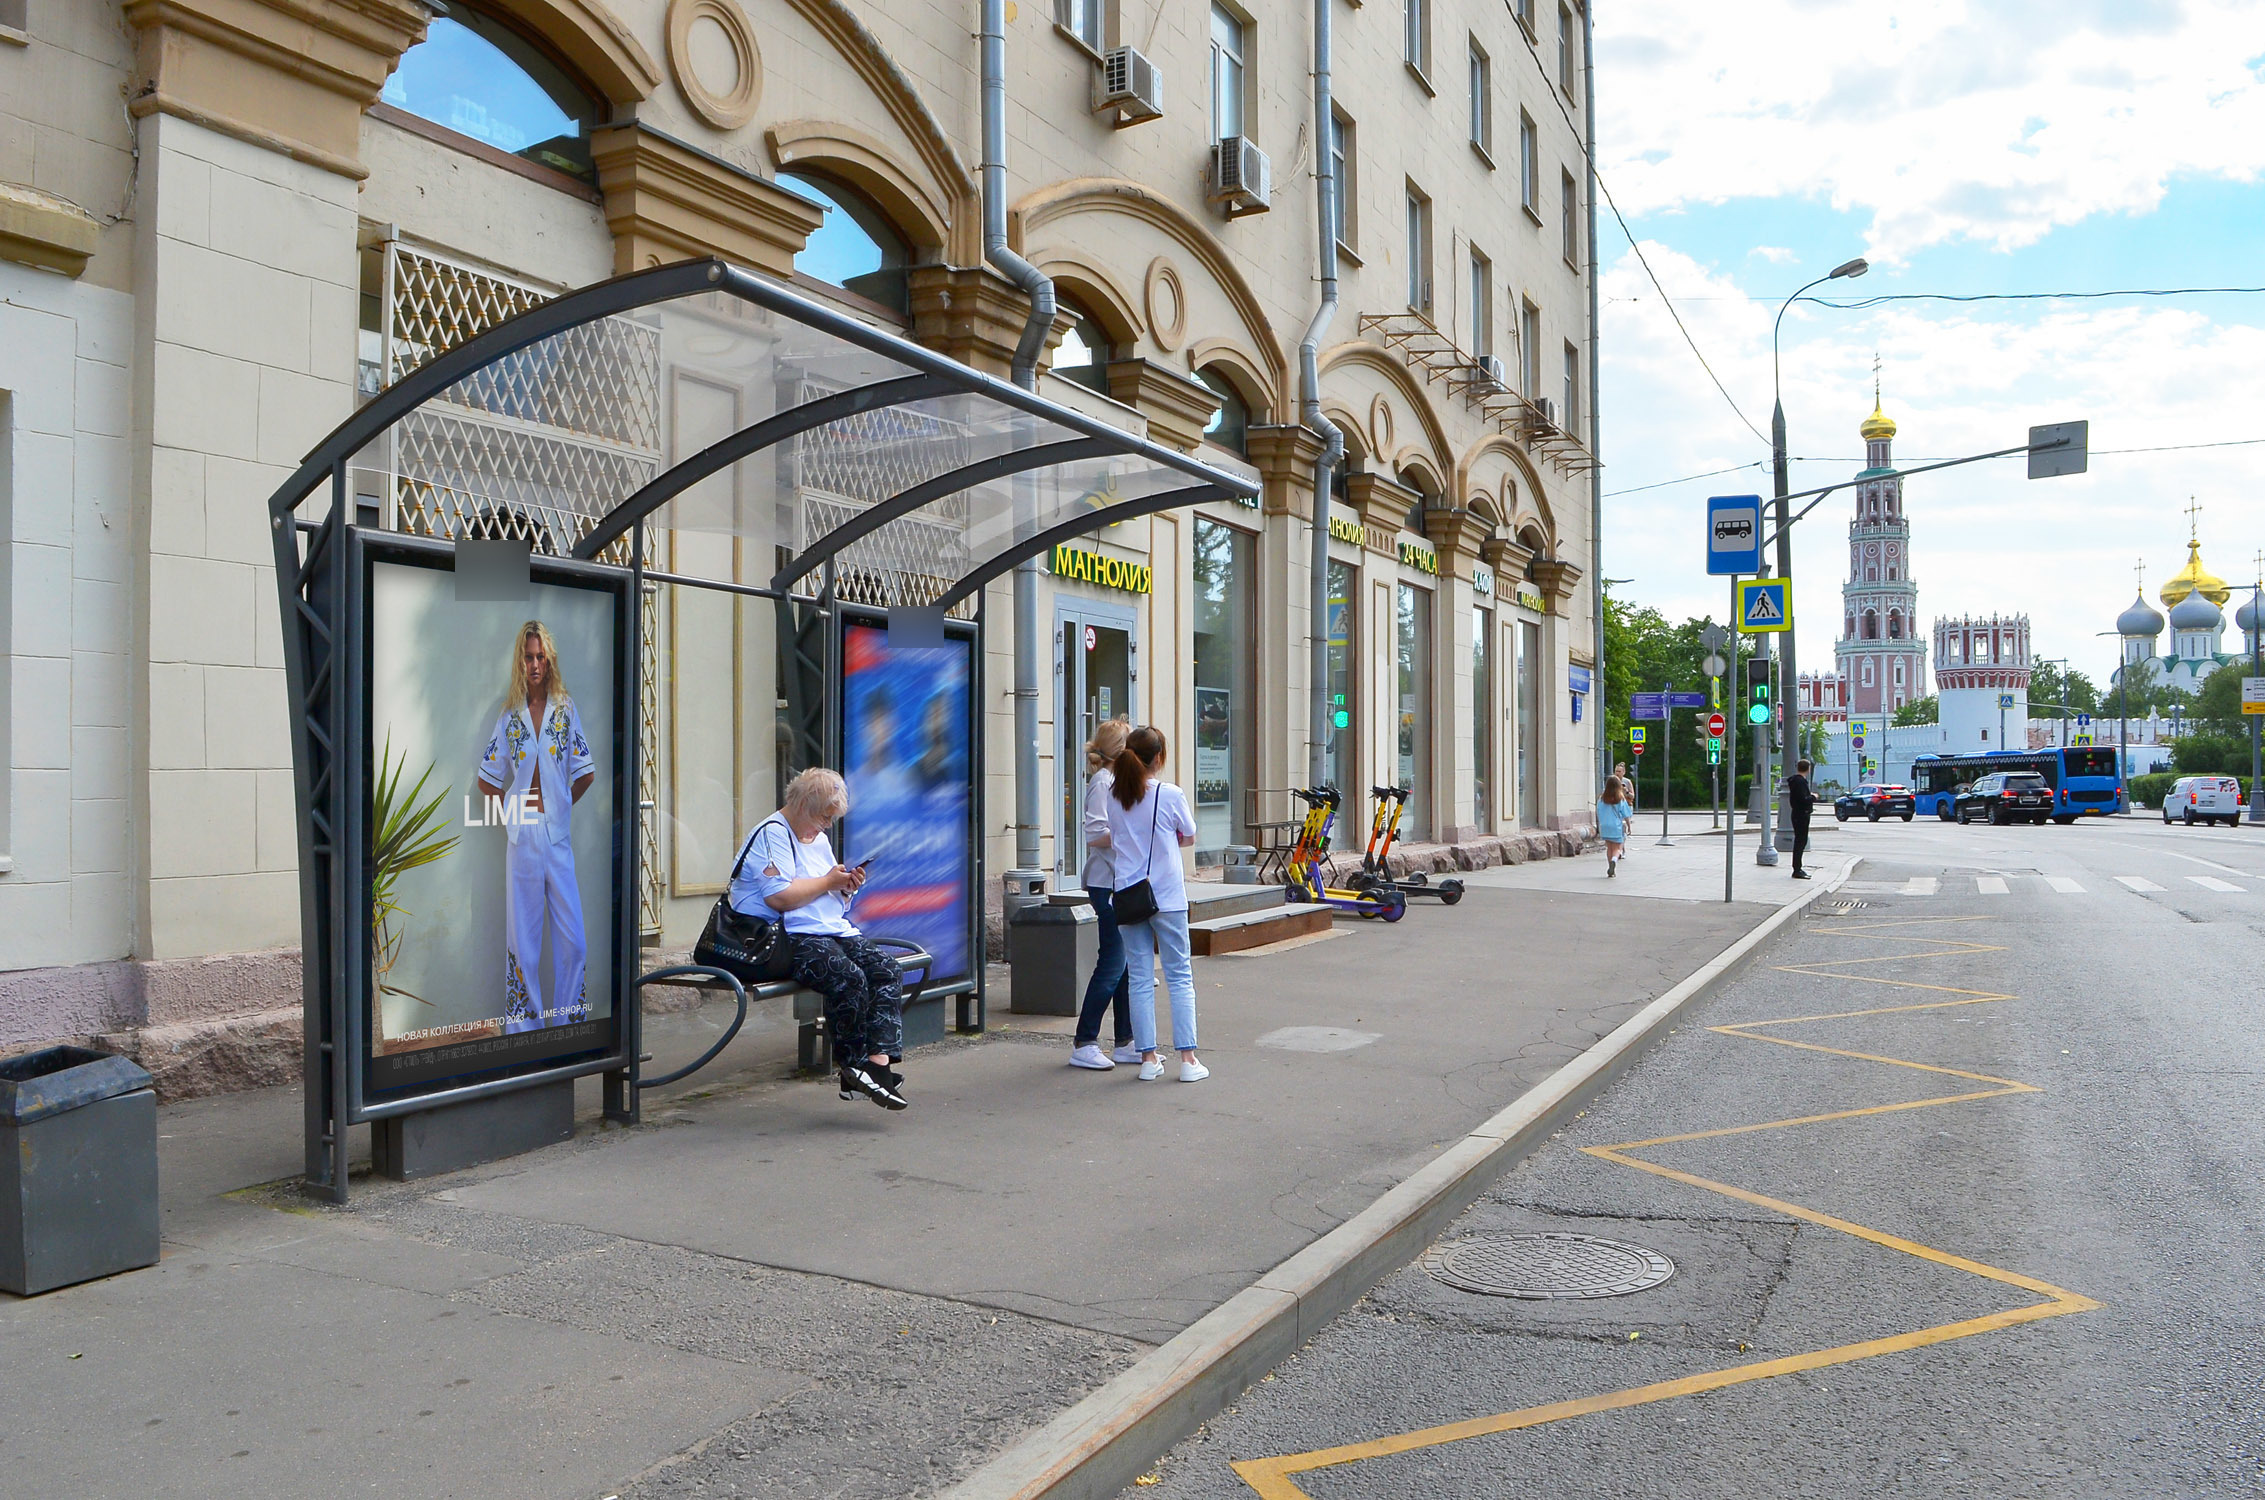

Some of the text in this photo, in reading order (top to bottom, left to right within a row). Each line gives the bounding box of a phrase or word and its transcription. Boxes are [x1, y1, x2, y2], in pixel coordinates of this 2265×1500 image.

[1328, 517, 1364, 546] АГНОЛИЯ
[1055, 544, 1152, 595] МАГНОЛИЯ
[1404, 543, 1438, 575] 24 ЧАСА
[1756, 685, 1768, 698] 17
[539, 1003, 593, 1019] LIME-SHOP.RU
[397, 1013, 525, 1042] НОВАЯ КОЛЛЕКЦИЯ ЛЕТО 2023
